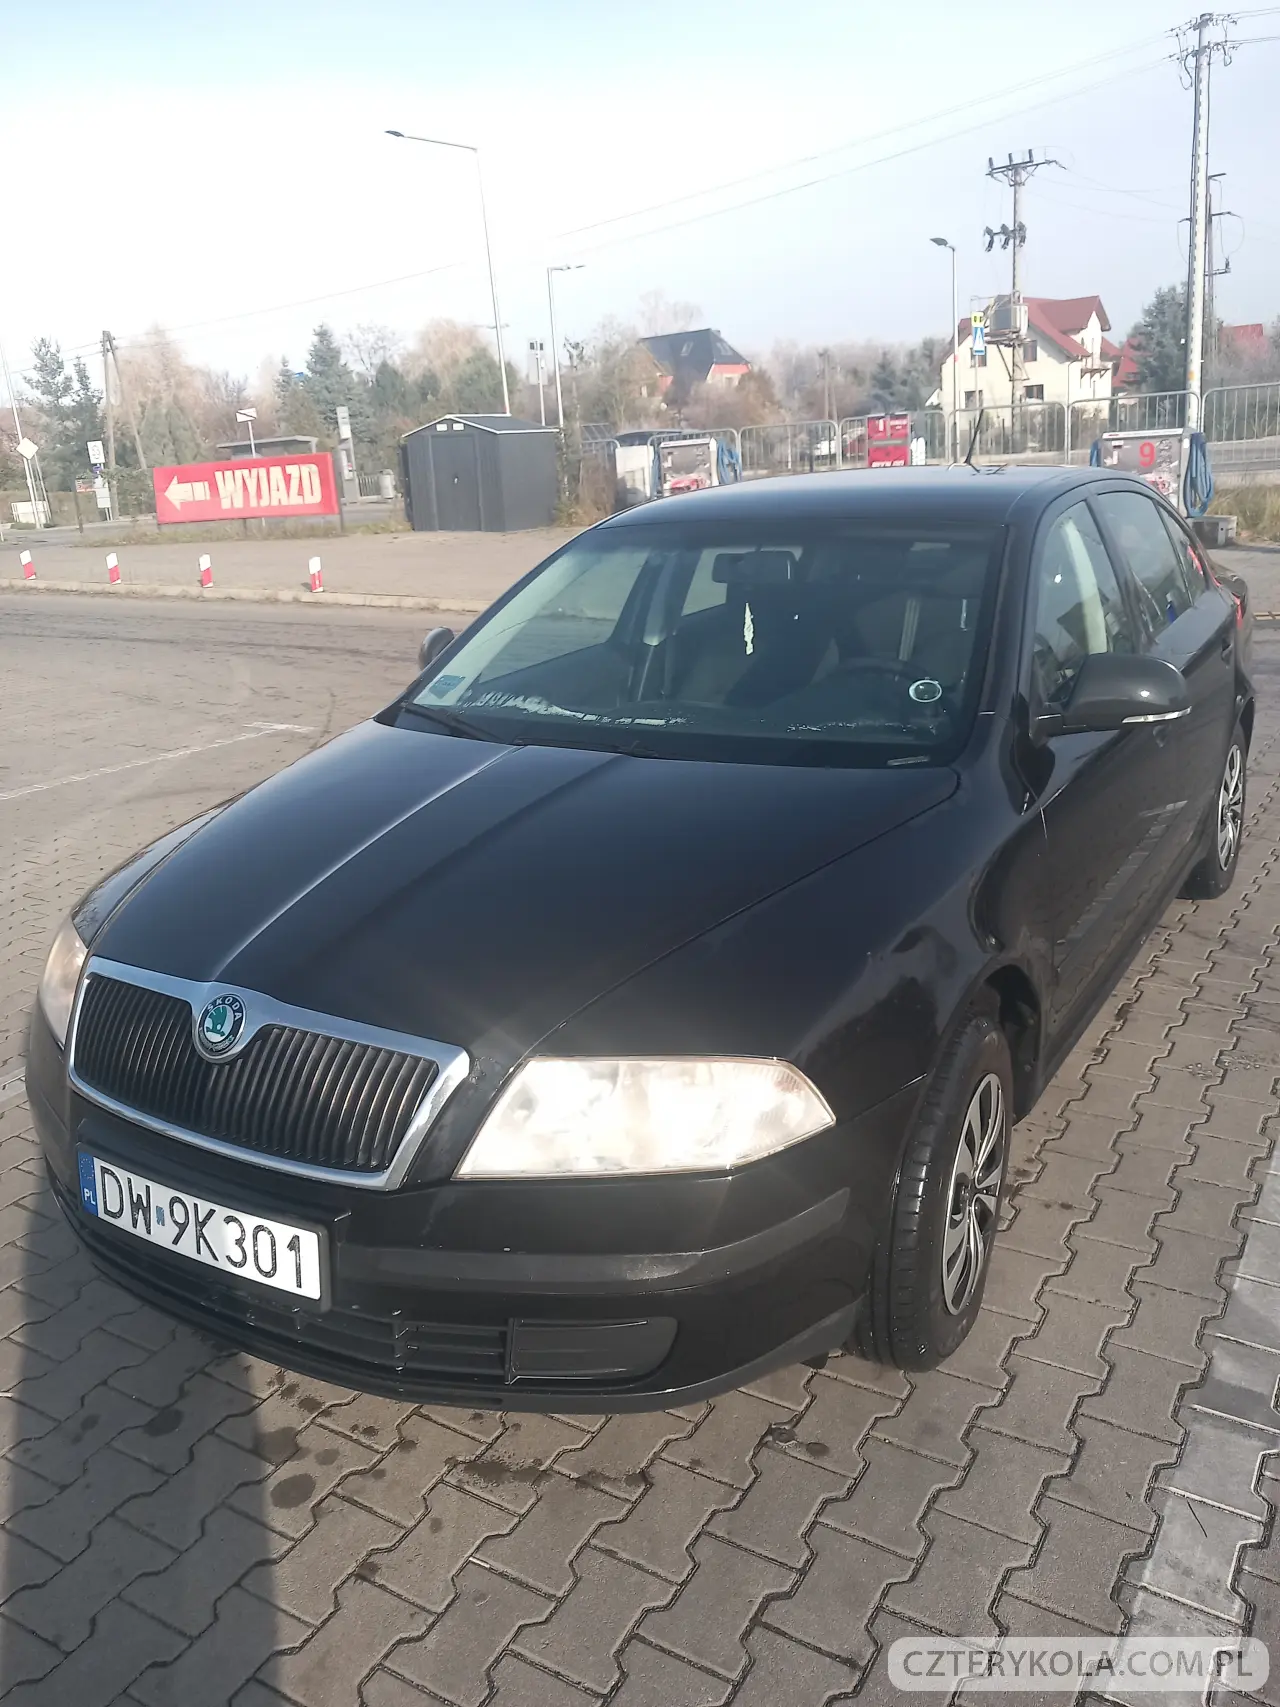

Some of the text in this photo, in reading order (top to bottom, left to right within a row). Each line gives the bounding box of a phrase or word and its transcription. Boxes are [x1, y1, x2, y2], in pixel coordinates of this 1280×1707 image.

[1139, 442, 1155, 467] 9
[215, 463, 322, 509] WYJAZD
[84, 1189, 96, 1205] PL
[99, 1166, 302, 1289] DW 9K301
